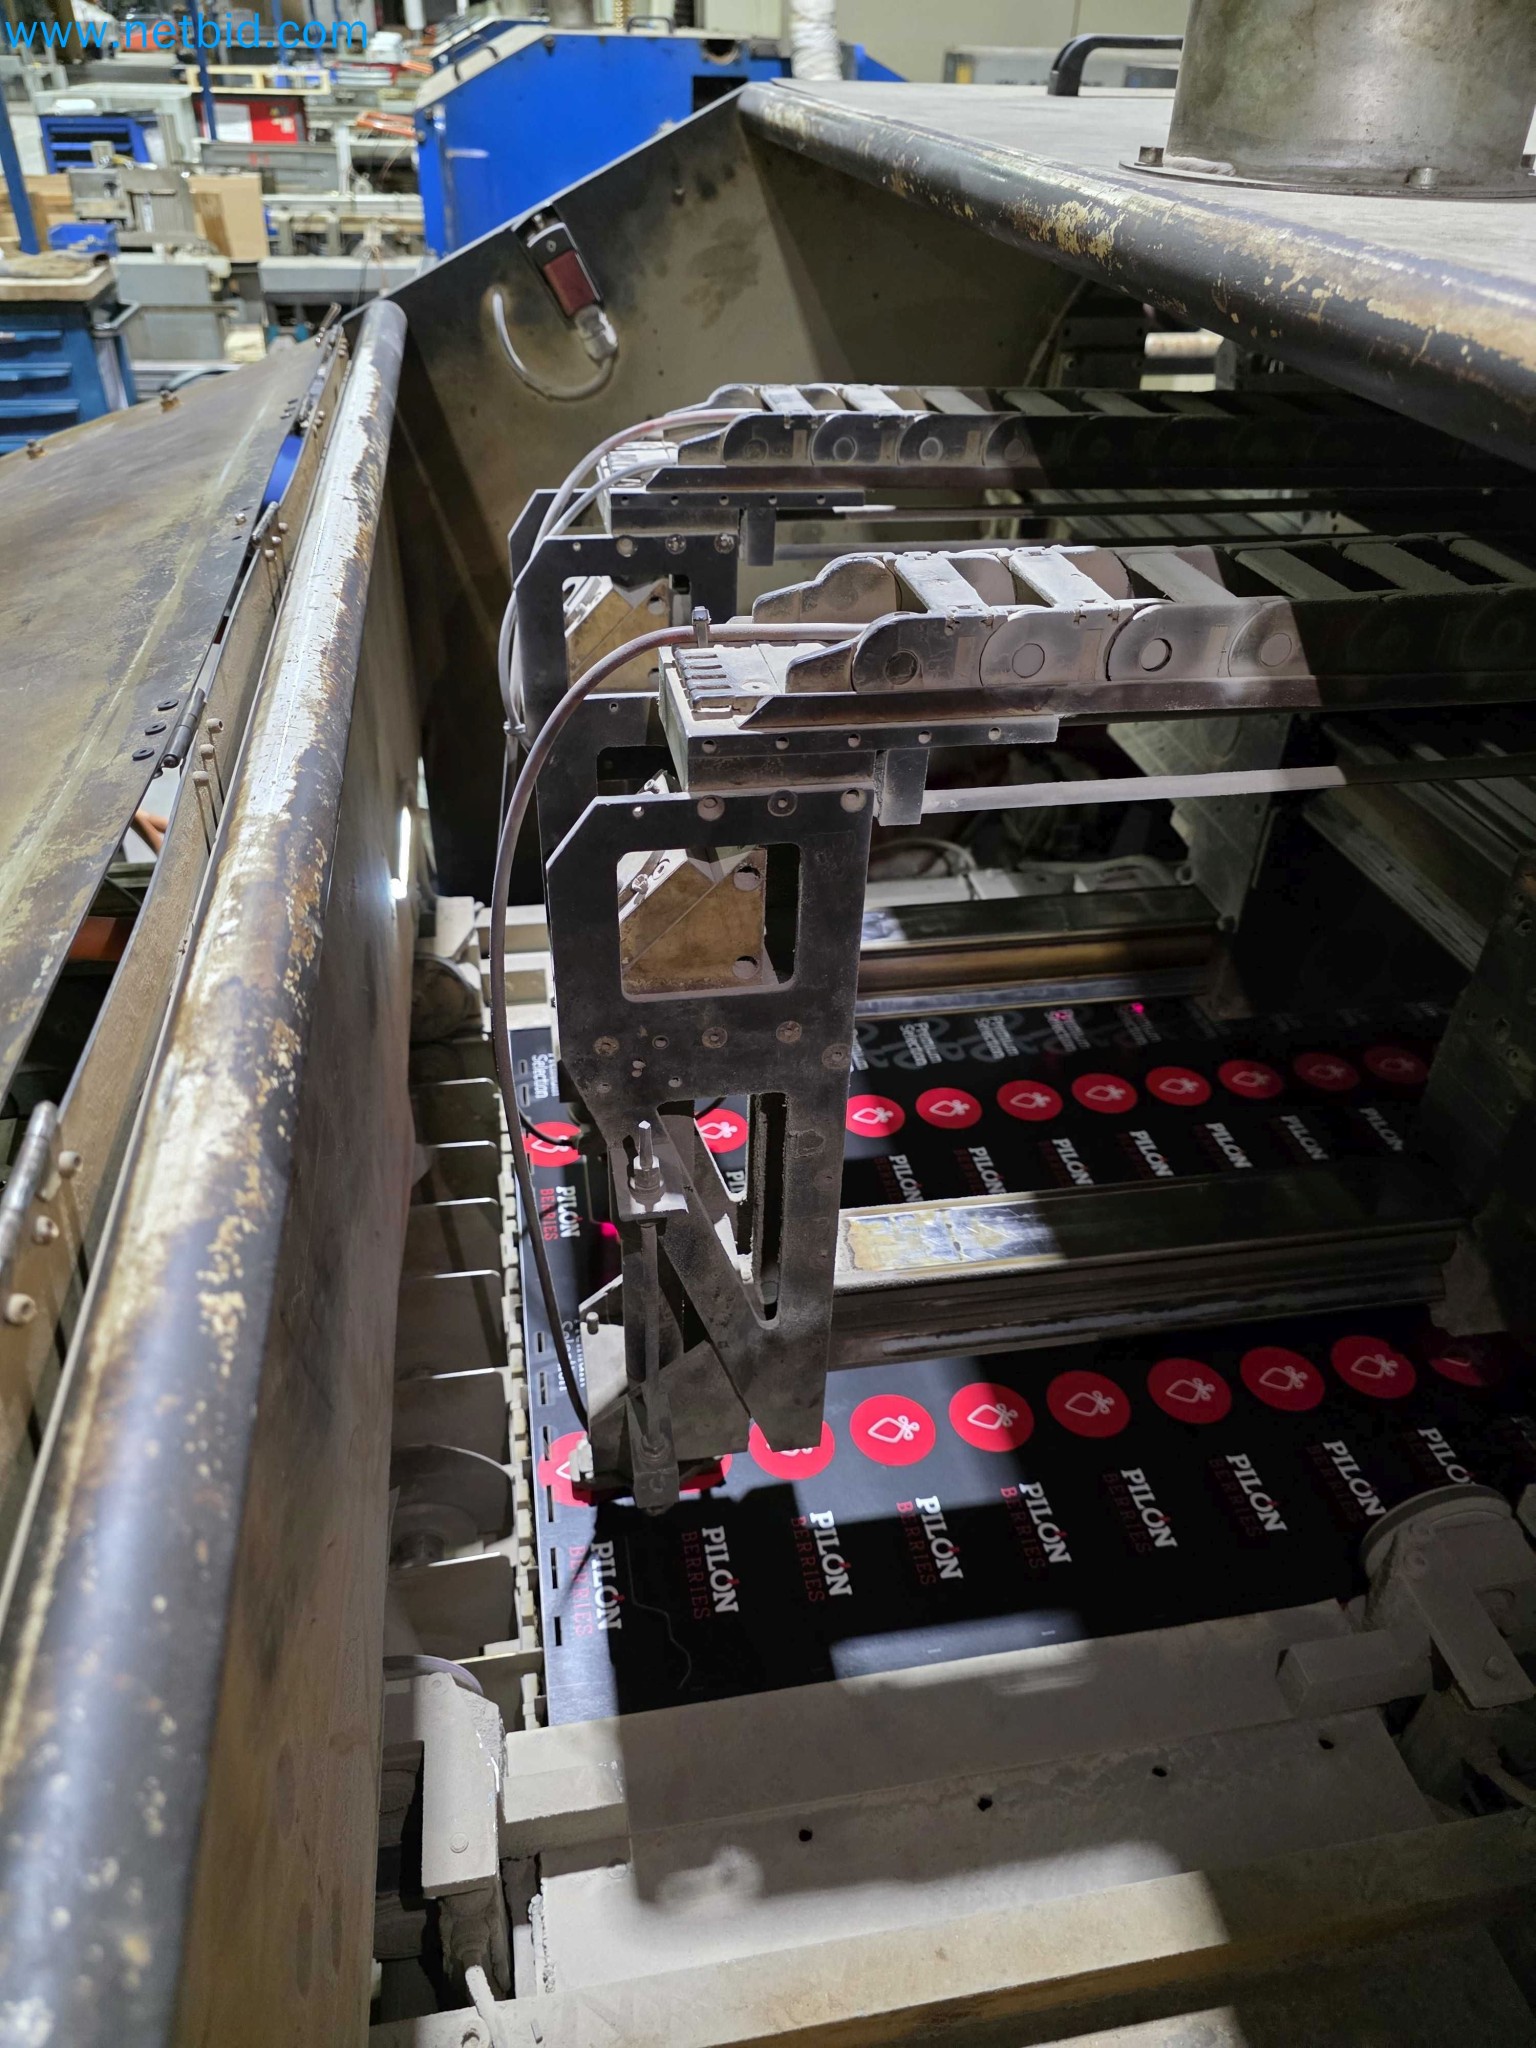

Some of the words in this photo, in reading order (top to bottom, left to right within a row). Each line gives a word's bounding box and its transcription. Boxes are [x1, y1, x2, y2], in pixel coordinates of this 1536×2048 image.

[531, 1054, 549, 1099] Selection
[790, 1515, 826, 1602] BERRIES
[896, 1501, 936, 1585] BERRIES
[1000, 1486, 1046, 1569] BERRIES
[568, 1546, 593, 1635] BERRIES
[681, 1531, 711, 1620] BERRIES
